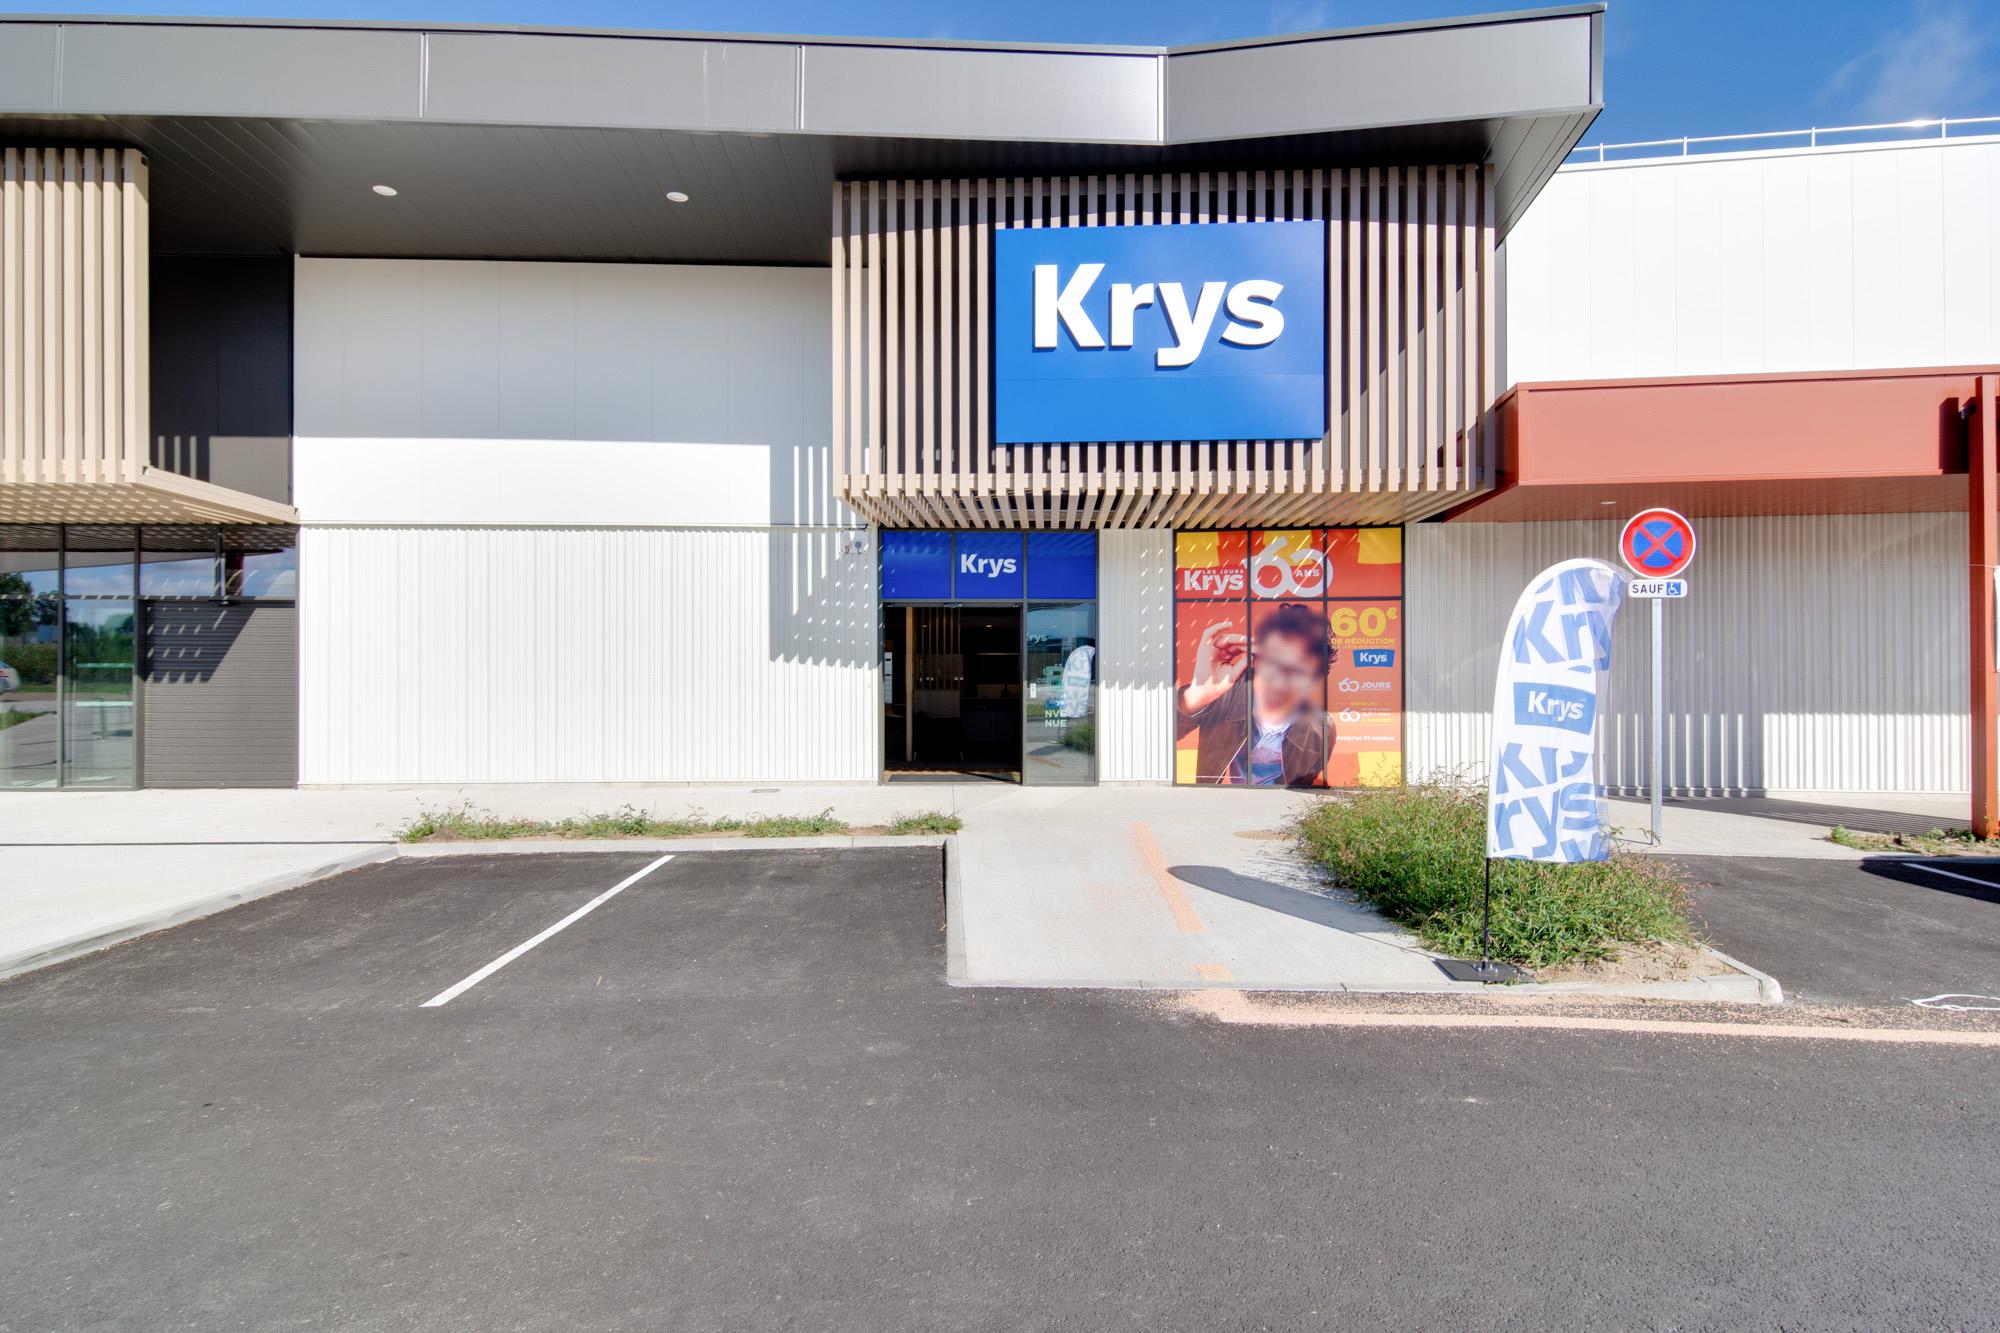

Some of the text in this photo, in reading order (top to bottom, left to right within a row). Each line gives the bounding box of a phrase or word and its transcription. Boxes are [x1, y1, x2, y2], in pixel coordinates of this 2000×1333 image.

[1033, 263, 1285, 370] Krys
[961, 553, 1017, 578] Krys
[1296, 569, 1319, 577] ANS
[1184, 570, 1244, 595] Krys
[1632, 584, 1664, 594] SAUF
[1026, 633, 1048, 644] rys
[1360, 653, 1388, 665] Krys
[1338, 678, 1392, 692] 60 JOURS
[1527, 690, 1585, 722] Krys
